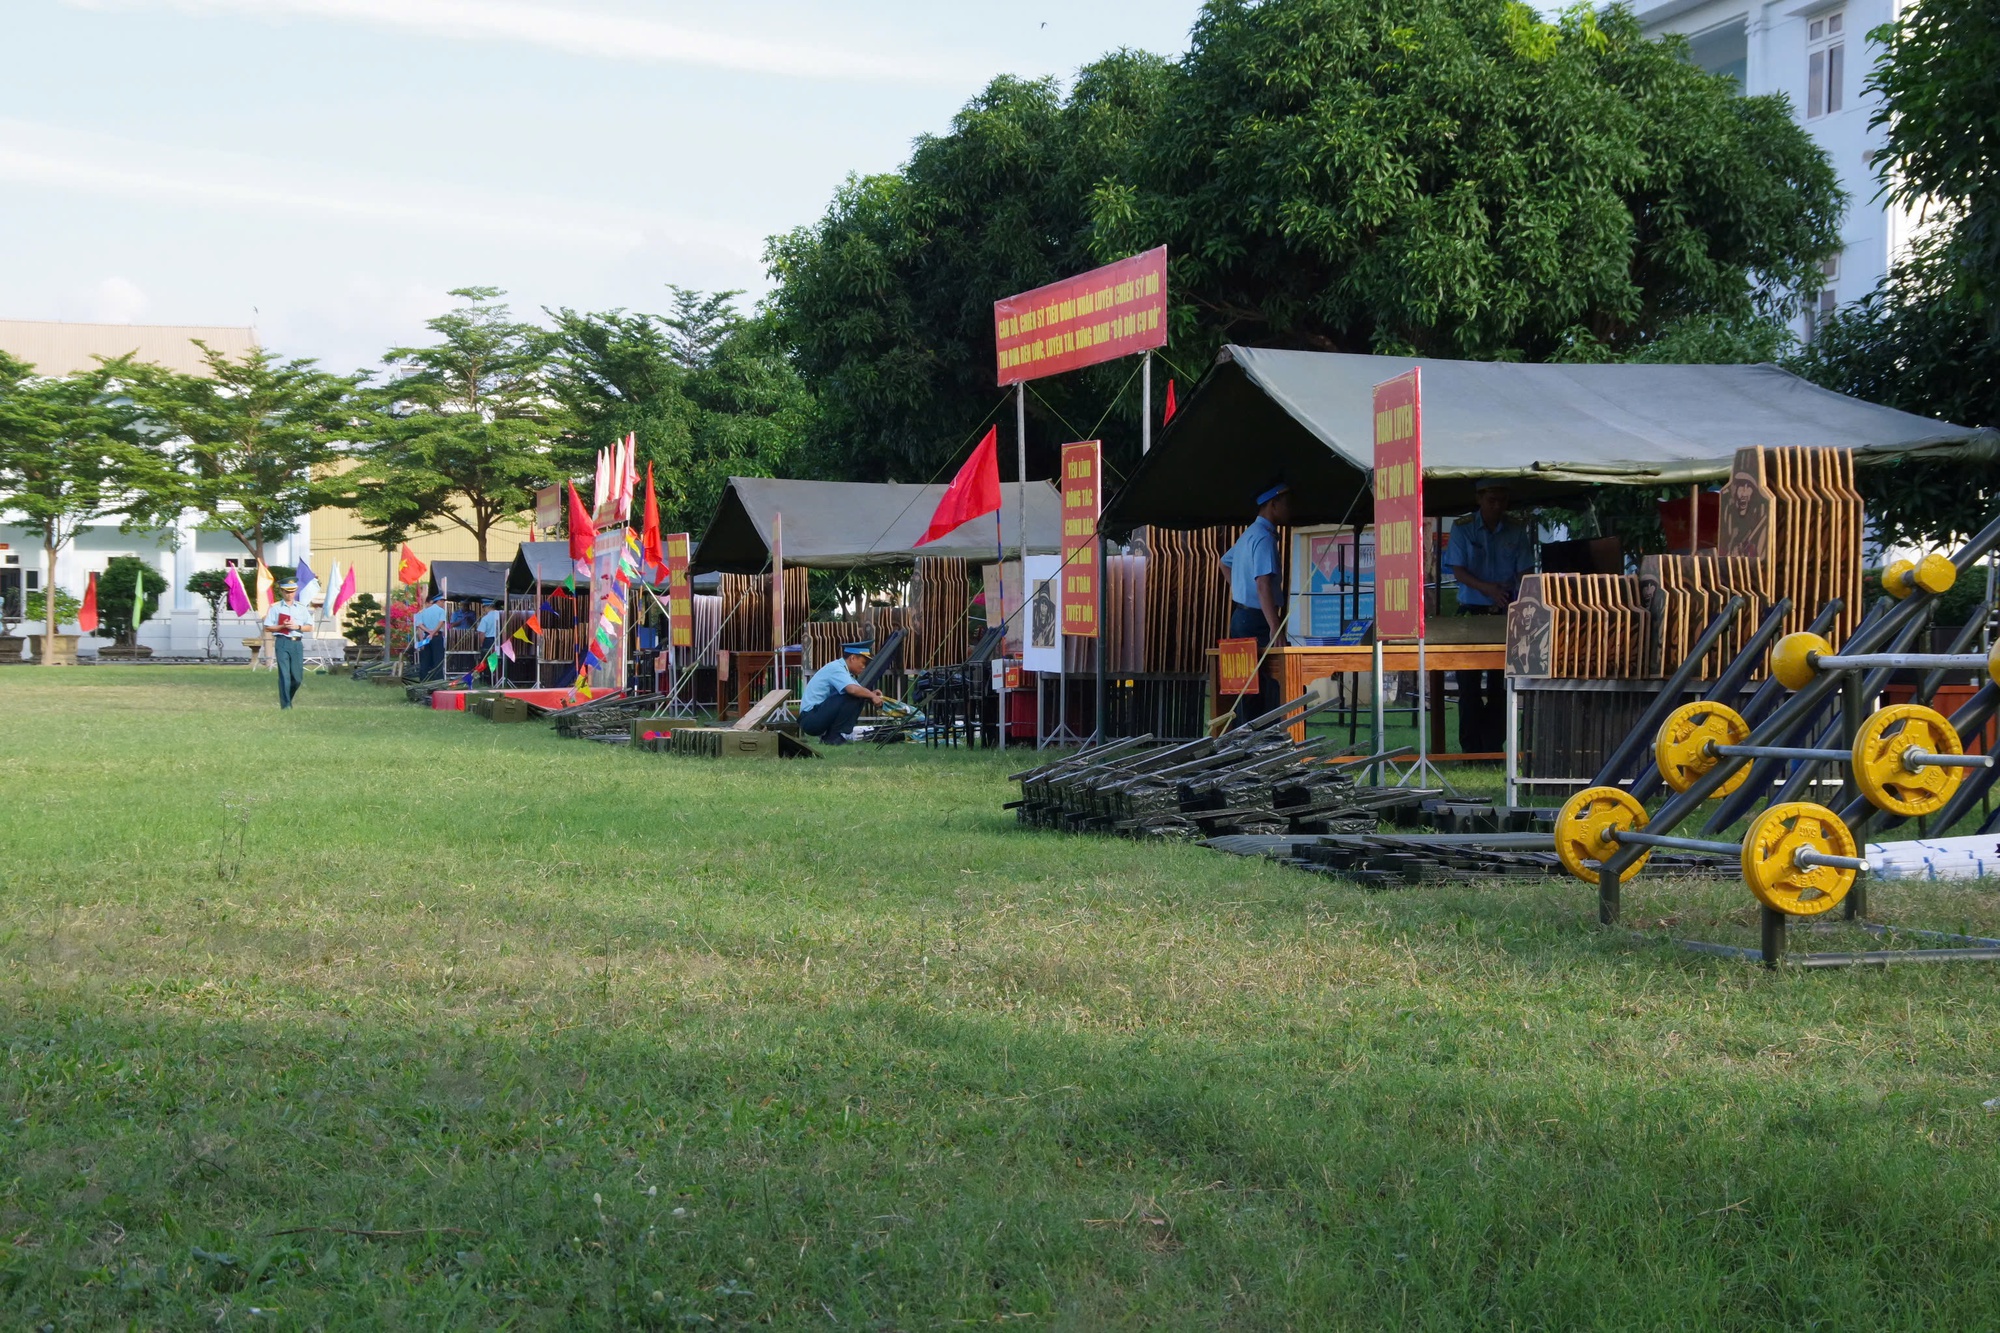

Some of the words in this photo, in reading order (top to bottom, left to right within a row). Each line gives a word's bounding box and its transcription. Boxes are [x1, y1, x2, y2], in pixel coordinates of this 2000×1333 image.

[1020, 306, 1036, 333] CHIẾN
[1076, 288, 1094, 317] HUẤN
[1095, 285, 1113, 312] LUYỆN
[1114, 275, 1134, 305] CHIẾN
[1145, 270, 1159, 296] MỚI
[1046, 333, 1063, 358] LUYỆN
[1093, 321, 1110, 346] DANH
[1124, 311, 1136, 339] ĐỘI
[1377, 400, 1393, 445] HUẤN
[1394, 399, 1413, 445] LUYỆN
[1066, 487, 1081, 510] ĐỘNG
[1082, 486, 1093, 507] TÁC
[1377, 457, 1388, 500] KẾT
[1389, 460, 1401, 504] HỢP
[1065, 516, 1081, 536] CHÍNH
[1083, 515, 1094, 535] XÁC
[1381, 517, 1392, 556] RÈN
[1393, 515, 1412, 560] LUYỆN
[1067, 576, 1076, 593] AN
[1076, 573, 1091, 593] TOÀN
[1394, 572, 1409, 617] LUẬT
[1065, 602, 1081, 625] TUYỆT
[1082, 600, 1093, 622] ĐỐI
